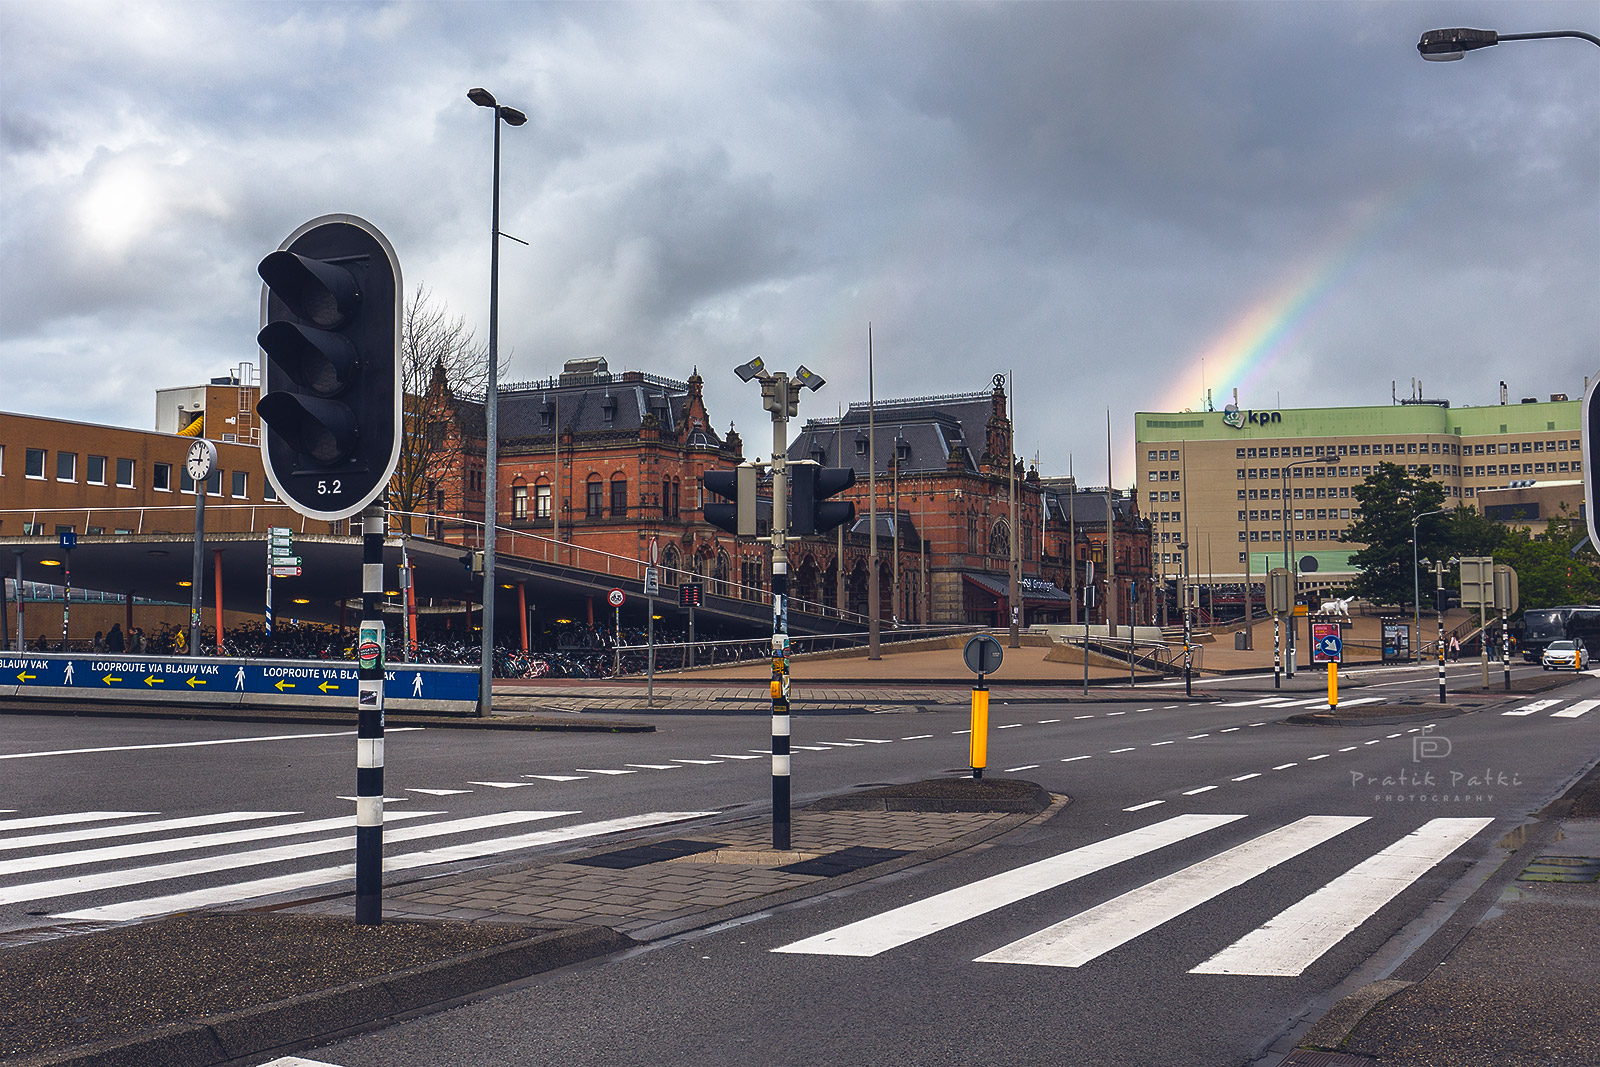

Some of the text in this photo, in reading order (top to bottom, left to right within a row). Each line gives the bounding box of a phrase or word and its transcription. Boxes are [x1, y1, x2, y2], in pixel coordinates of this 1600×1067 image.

[1248, 409, 1281, 426] kpn
[317, 479, 342, 495] 5.2
[30, 660, 48, 669] VAK
[91, 661, 219, 675] LOOPROUTE VIA BLAUW VAK
[263, 667, 396, 681] LOOPROUTE VIA BLA AK
